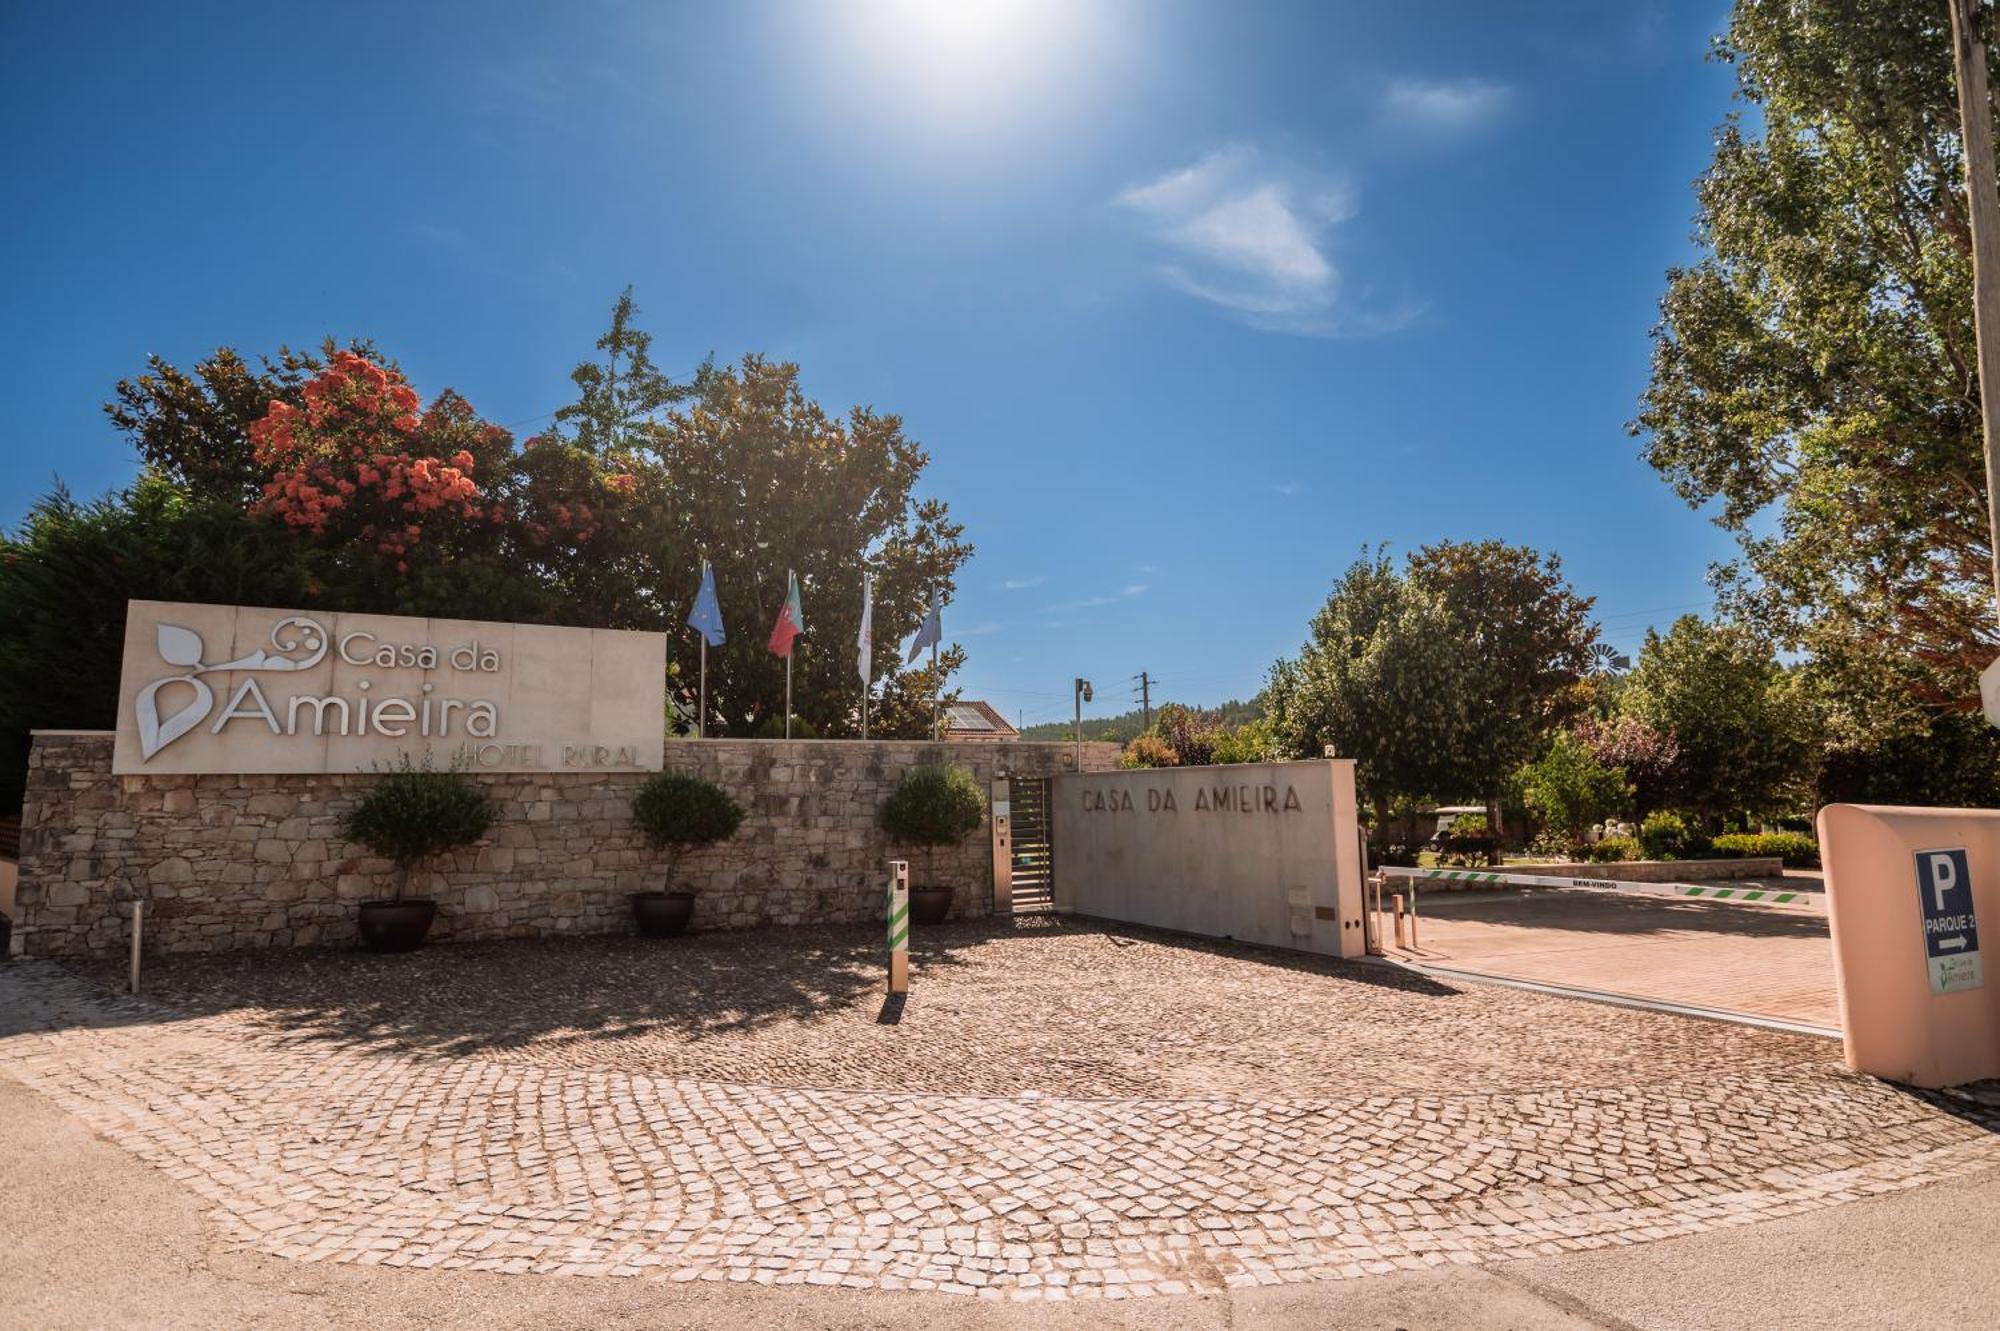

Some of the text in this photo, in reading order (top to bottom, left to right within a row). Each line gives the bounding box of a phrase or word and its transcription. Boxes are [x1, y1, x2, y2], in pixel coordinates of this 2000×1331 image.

[340, 631, 499, 672] Casa da
[210, 676, 498, 737] Amieira
[464, 743, 645, 769] HOTEL RURAL
[1081, 784, 1302, 814] CASA DA AMIEIRA
[1572, 880, 1617, 889] BEM-VINDO
[1930, 854, 1956, 910] P
[1926, 915, 1976, 933] PARQUE 2
